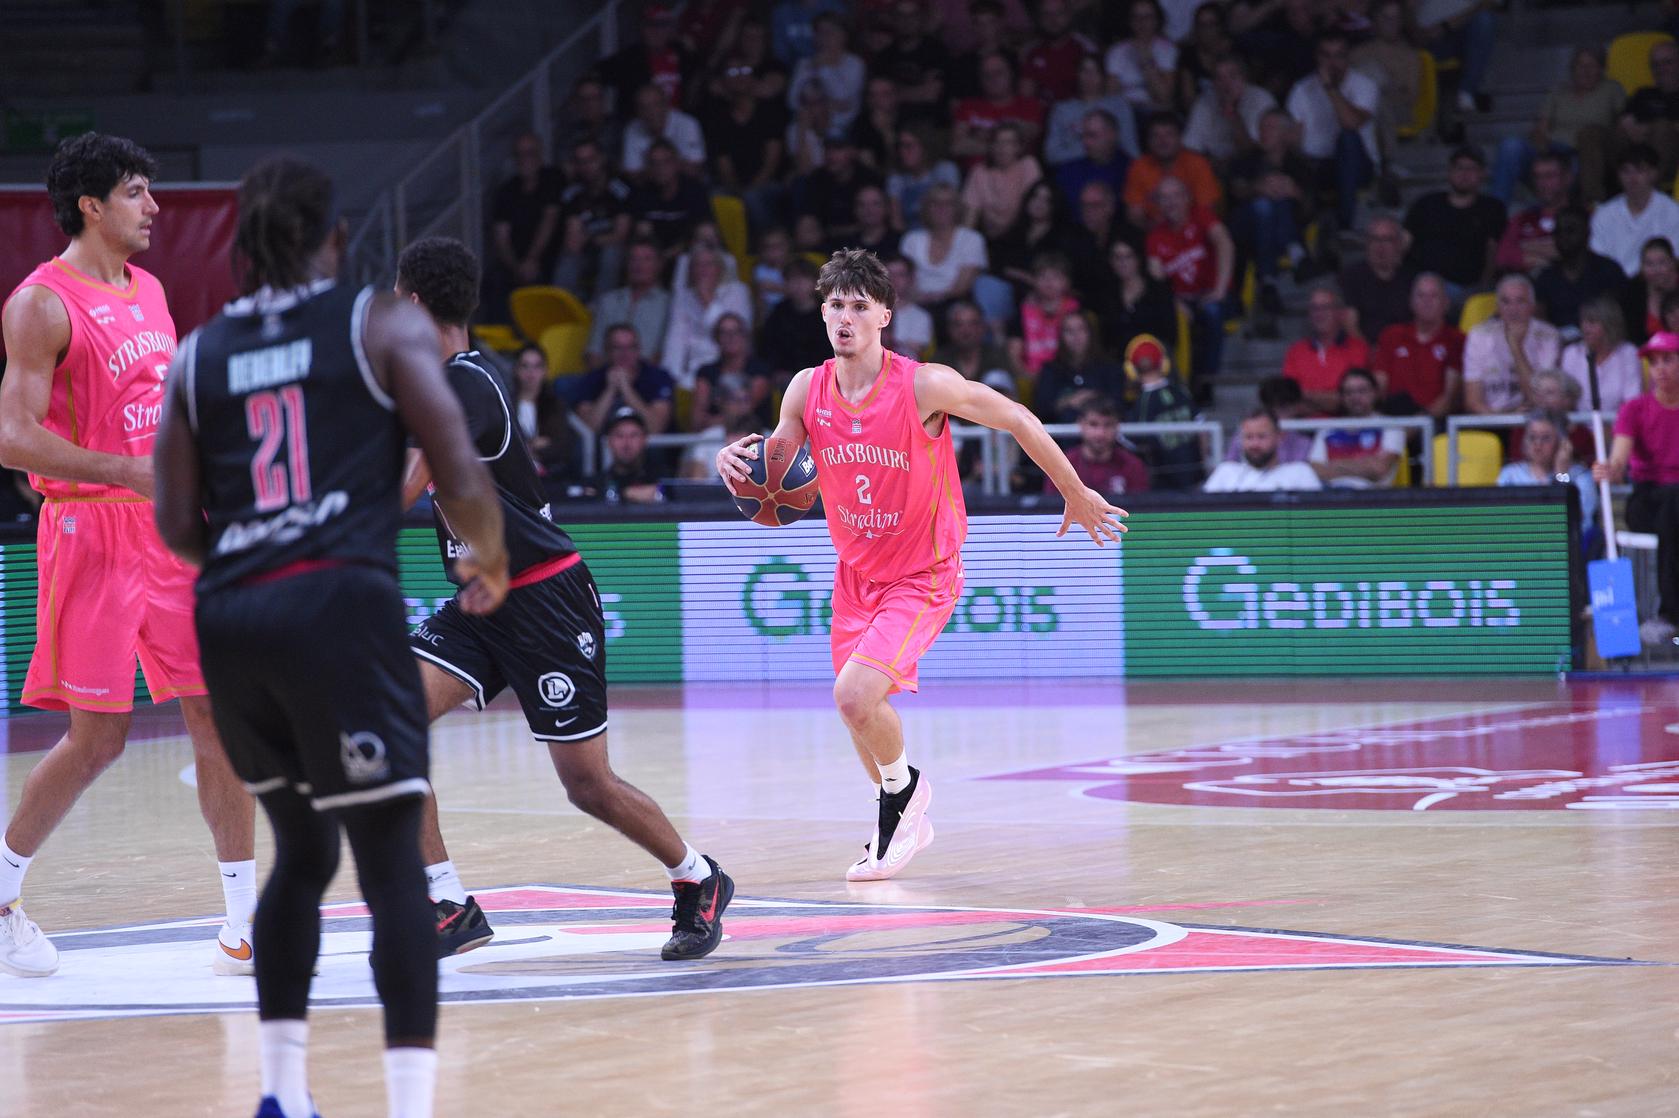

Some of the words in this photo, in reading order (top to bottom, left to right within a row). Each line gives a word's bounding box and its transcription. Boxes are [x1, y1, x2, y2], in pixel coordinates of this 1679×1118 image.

[108, 330, 178, 383] STRASBOU
[123, 403, 162, 432] Stra
[245, 383, 312, 513] 21
[821, 443, 911, 472] TRASBOURG
[855, 474, 872, 505] 2
